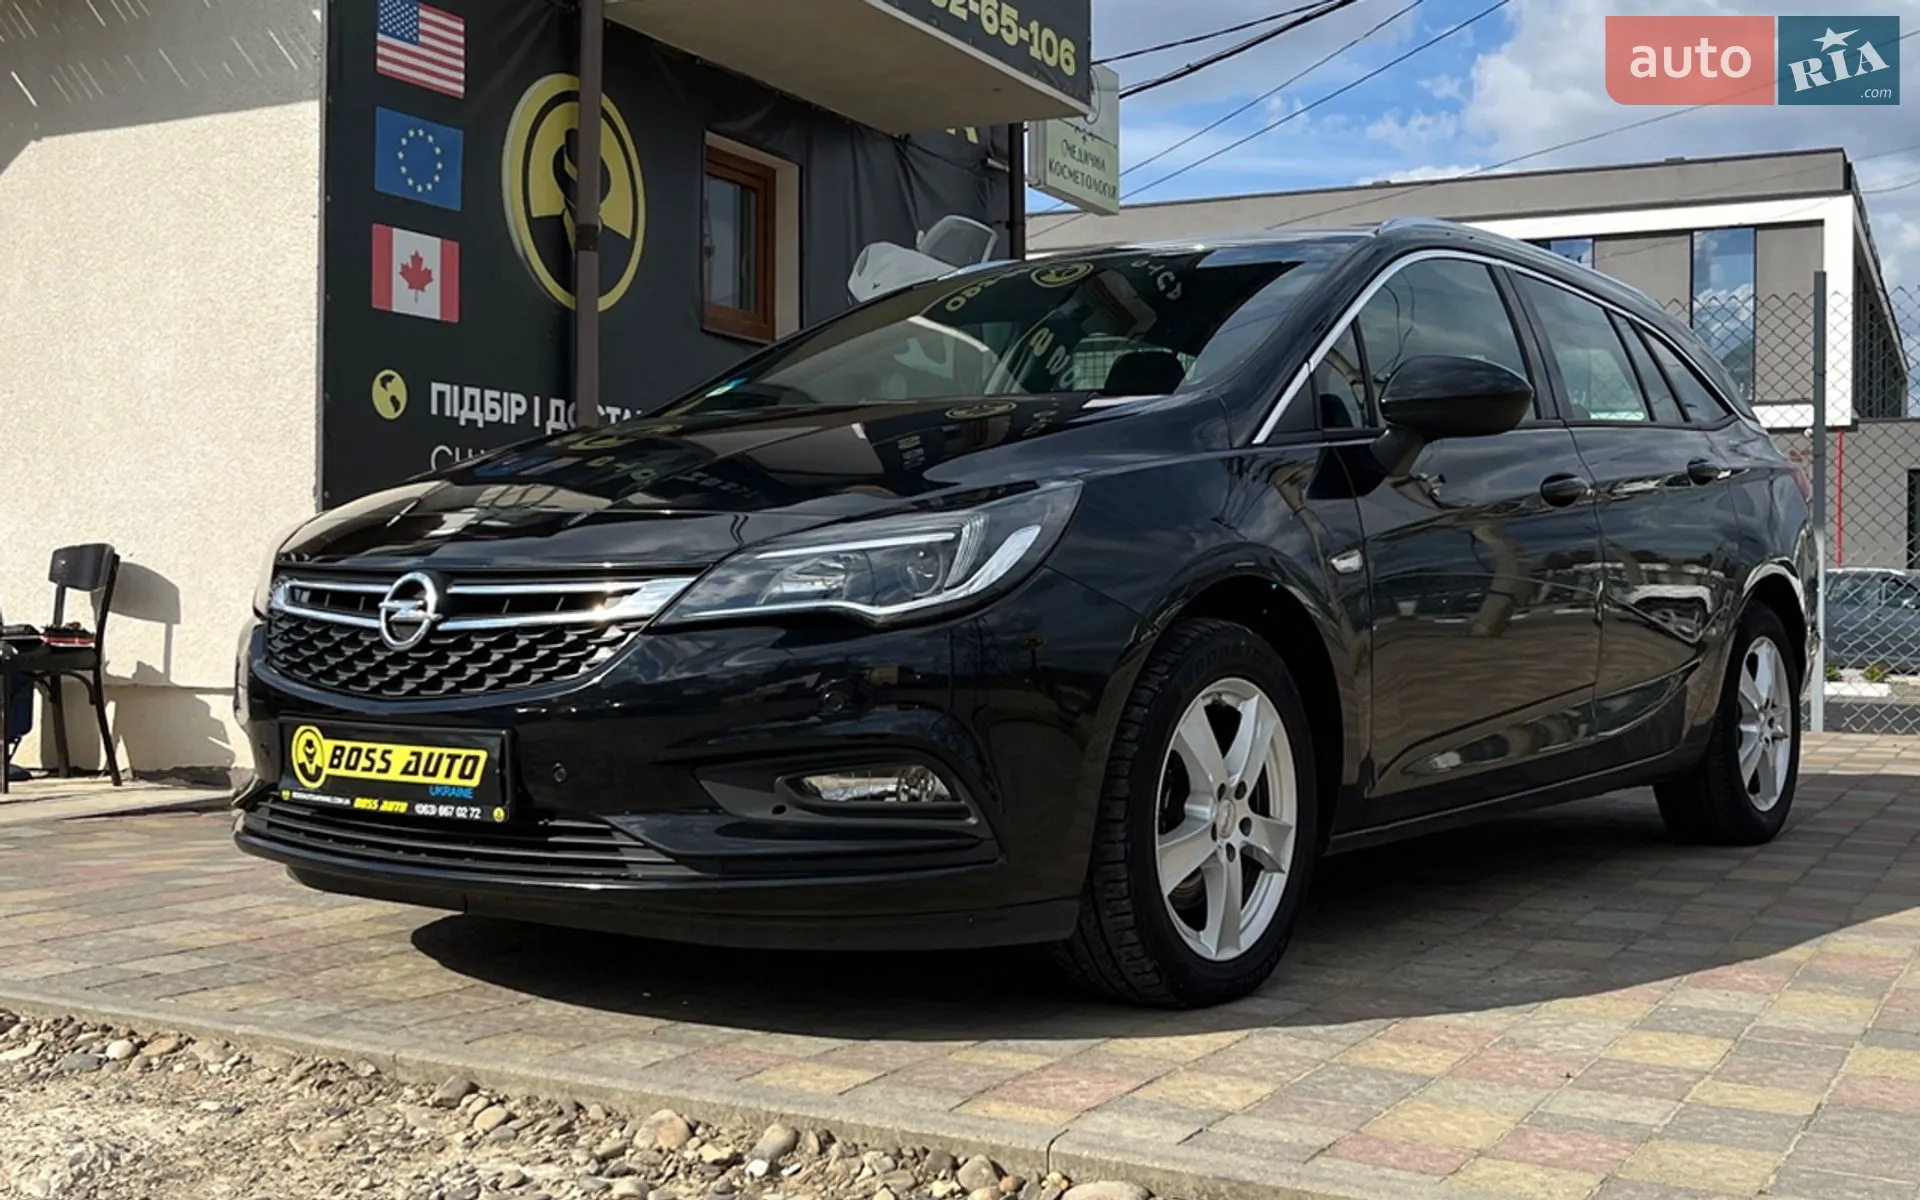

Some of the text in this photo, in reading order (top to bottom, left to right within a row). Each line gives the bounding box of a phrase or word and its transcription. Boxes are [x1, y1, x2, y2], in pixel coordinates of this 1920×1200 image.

[930, 0, 1077, 77] 2-65-106
[430, 382, 528, 428] ПІДБІР
[328, 745, 481, 780] BOSS AUTO
[428, 786, 475, 799] UKRAINE
